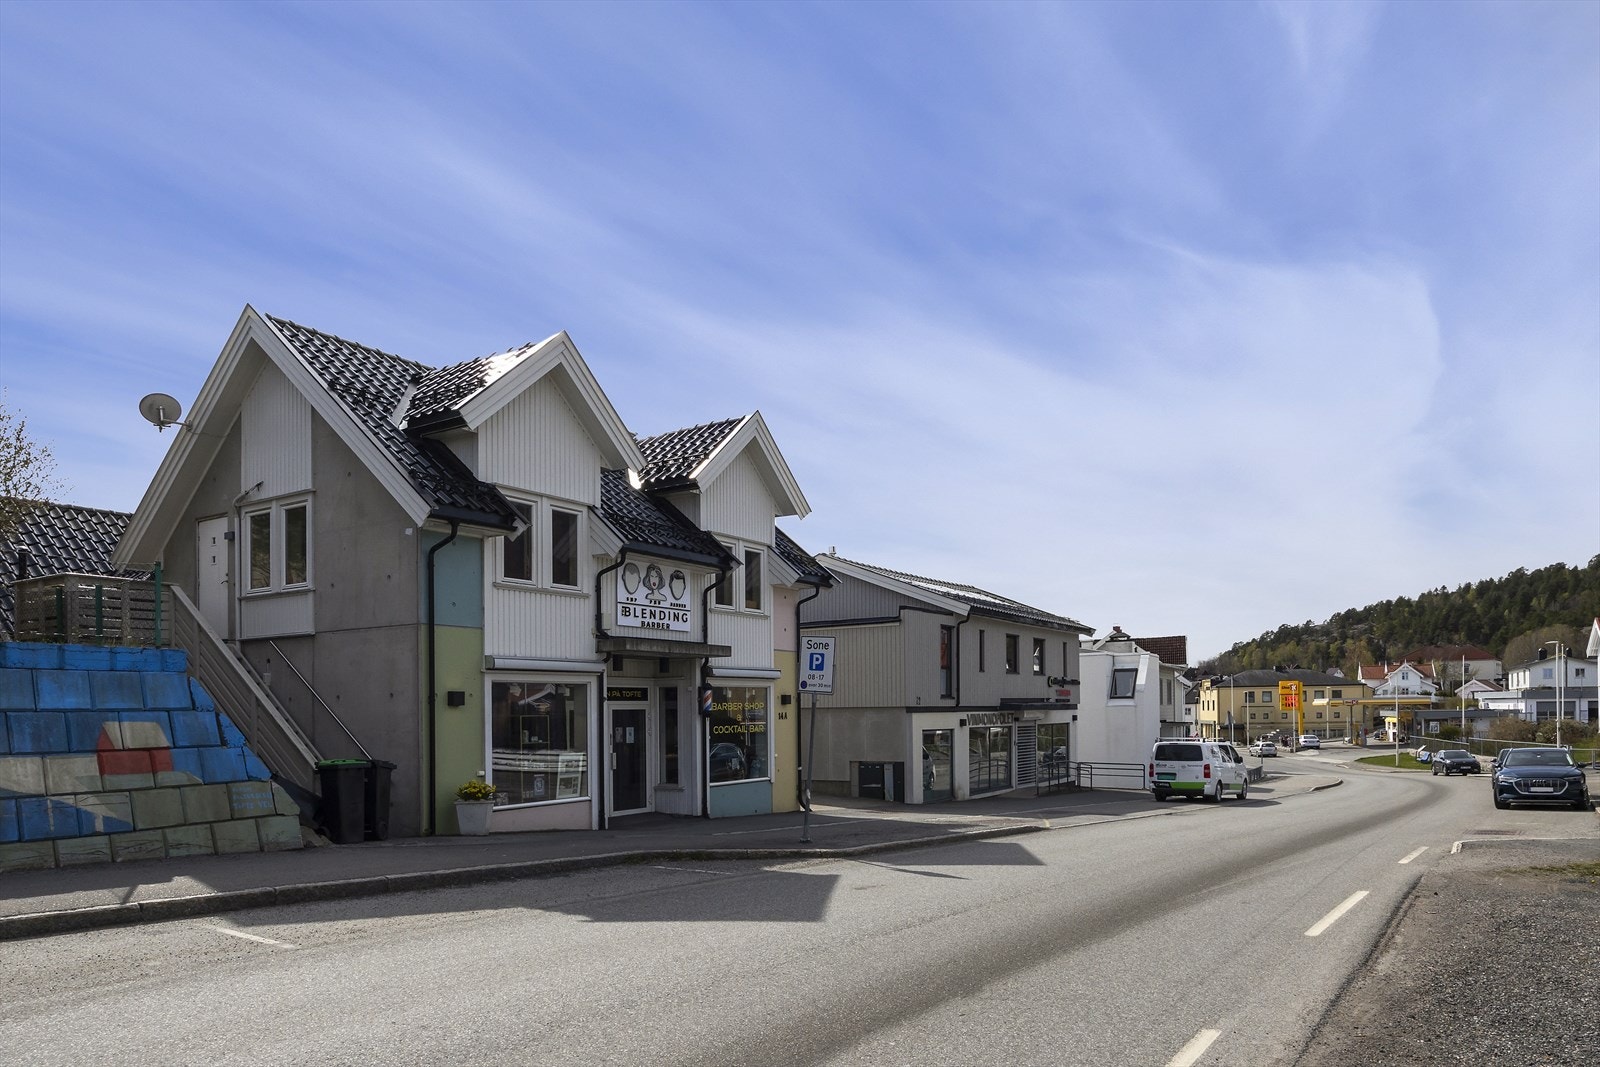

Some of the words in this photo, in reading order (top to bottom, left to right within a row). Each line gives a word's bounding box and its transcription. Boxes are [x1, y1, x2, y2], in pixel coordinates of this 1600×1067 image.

[624, 606, 688, 623] BLENDING
[641, 621, 670, 630] BARBER
[806, 639, 829, 650] Sone
[812, 654, 822, 670] P
[622, 690, 642, 698] TOFTE
[712, 702, 742, 711] BARBER
[744, 702, 765, 710] SHOP
[778, 712, 788, 720] 14A
[966, 712, 1014, 726] VINMONOPOLET
[713, 725, 747, 734] COCKTAIL
[749, 724, 764, 733] BAR
